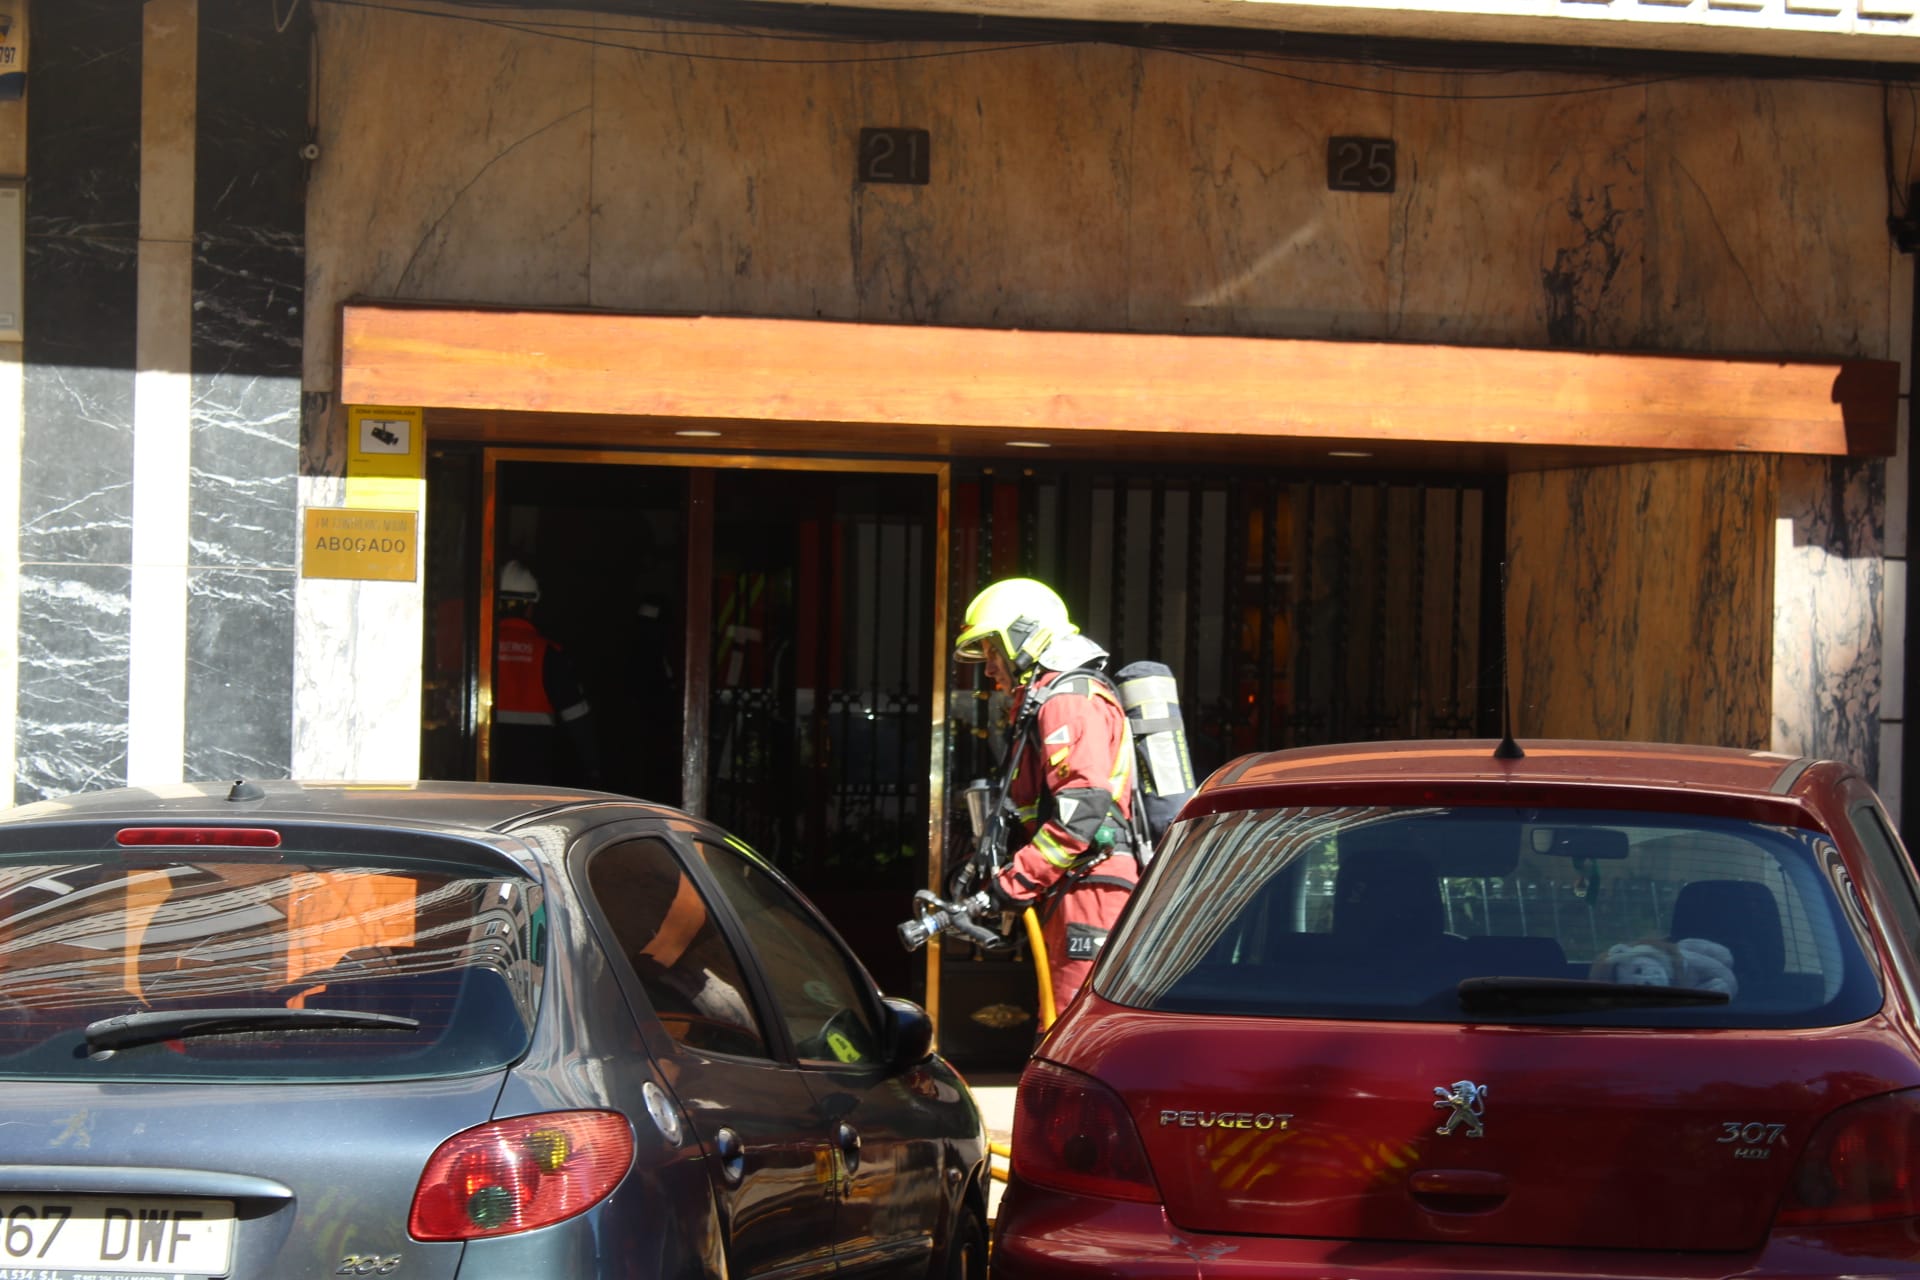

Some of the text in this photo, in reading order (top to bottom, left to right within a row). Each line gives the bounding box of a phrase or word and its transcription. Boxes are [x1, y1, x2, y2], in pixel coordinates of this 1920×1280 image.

[868, 133, 917, 178] 21
[1338, 142, 1391, 187] 25
[315, 536, 406, 553] ABOGADO
[1069, 937, 1092, 952] 214
[1159, 1109, 1295, 1130] PEUGEOT
[1716, 1121, 1786, 1145] 307
[0, 1204, 203, 1264] 67 DWF
[336, 1254, 402, 1275] 206
